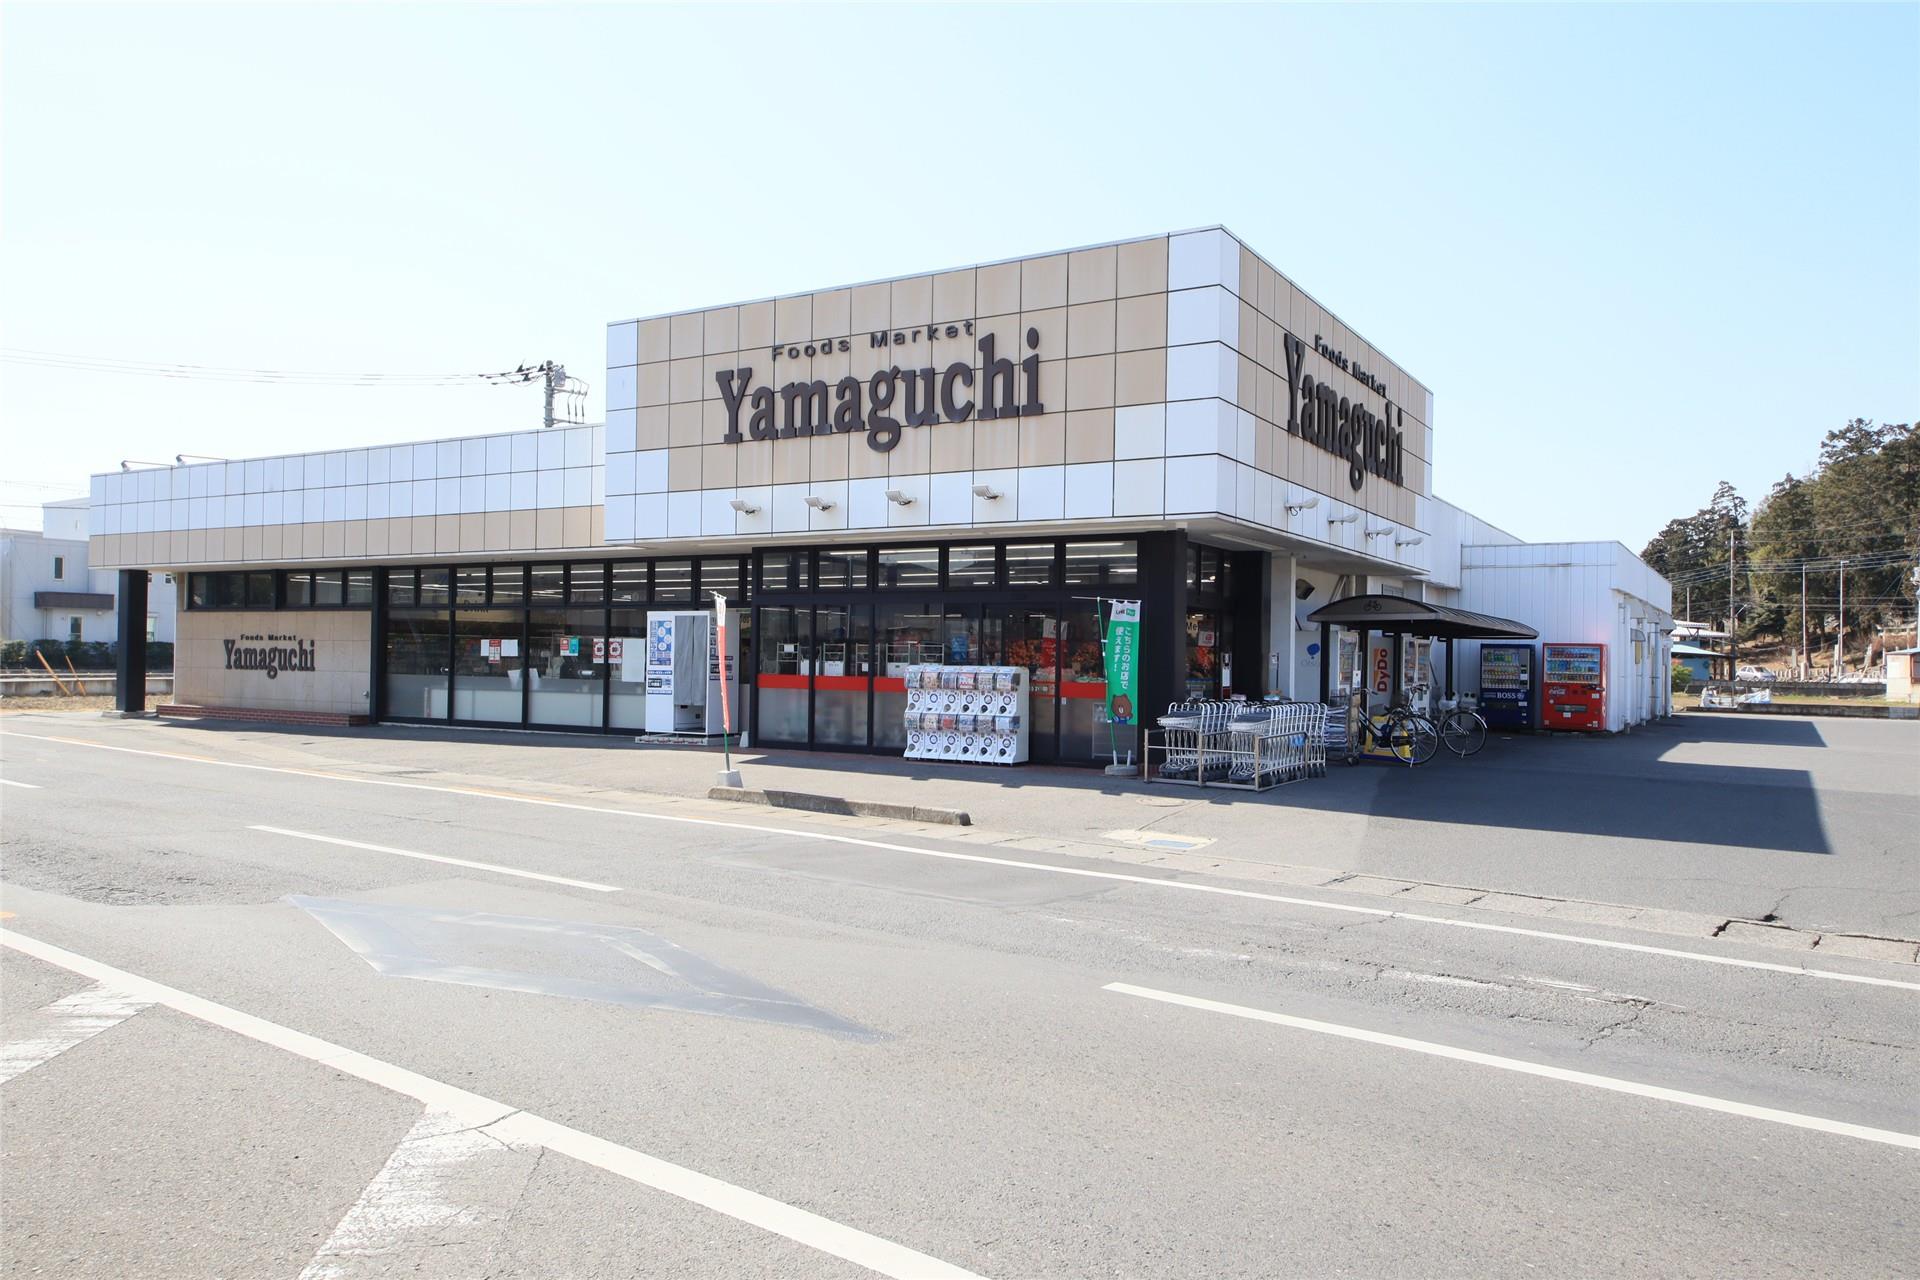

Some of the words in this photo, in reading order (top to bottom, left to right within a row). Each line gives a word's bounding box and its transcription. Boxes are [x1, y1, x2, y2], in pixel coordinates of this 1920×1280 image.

[771, 338, 851, 361] Foods
[869, 319, 974, 349] Market
[1314, 334, 1349, 372] Foods
[1352, 361, 1387, 398] Market
[715, 326, 1045, 453] Yamaguchi
[1283, 332, 1404, 491] Yamaguchi
[223, 639, 315, 679] Yamaguchi
[1120, 626, 1132, 690] こちらのお店で
[1377, 648, 1391, 692] DyDo
